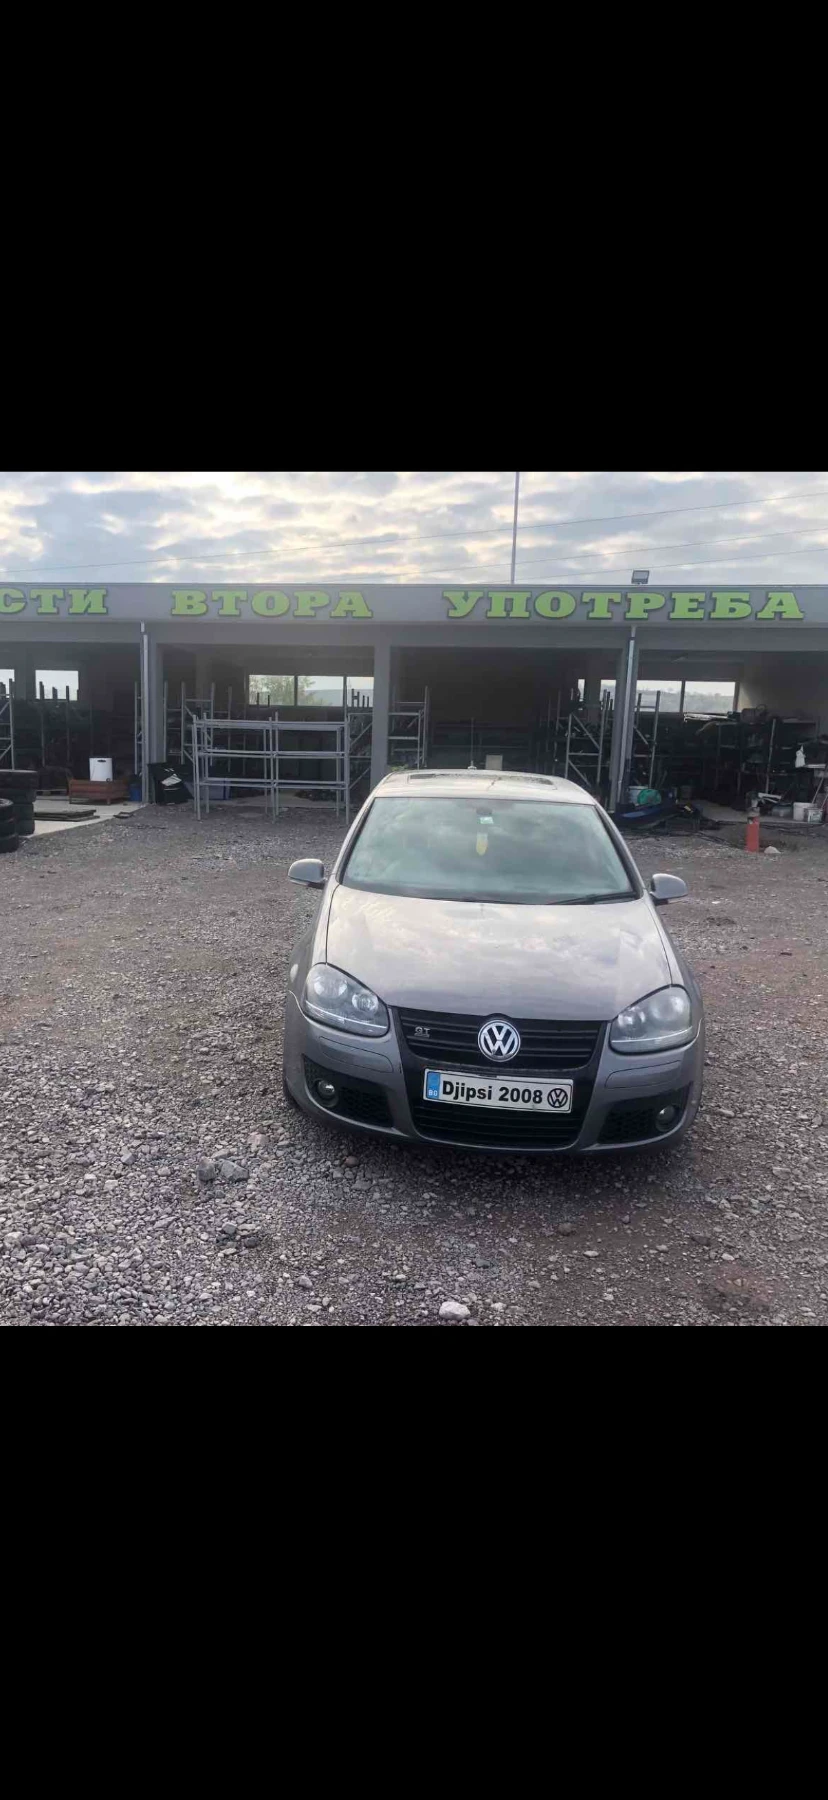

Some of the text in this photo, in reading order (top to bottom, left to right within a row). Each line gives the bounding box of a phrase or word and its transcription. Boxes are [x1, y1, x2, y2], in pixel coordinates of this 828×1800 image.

[171, 589, 374, 618] ВТОРА
[443, 590, 805, 621] УПОТРЕБА
[442, 1080, 492, 1101] Djipsi
[499, 1087, 542, 1104] 2008
